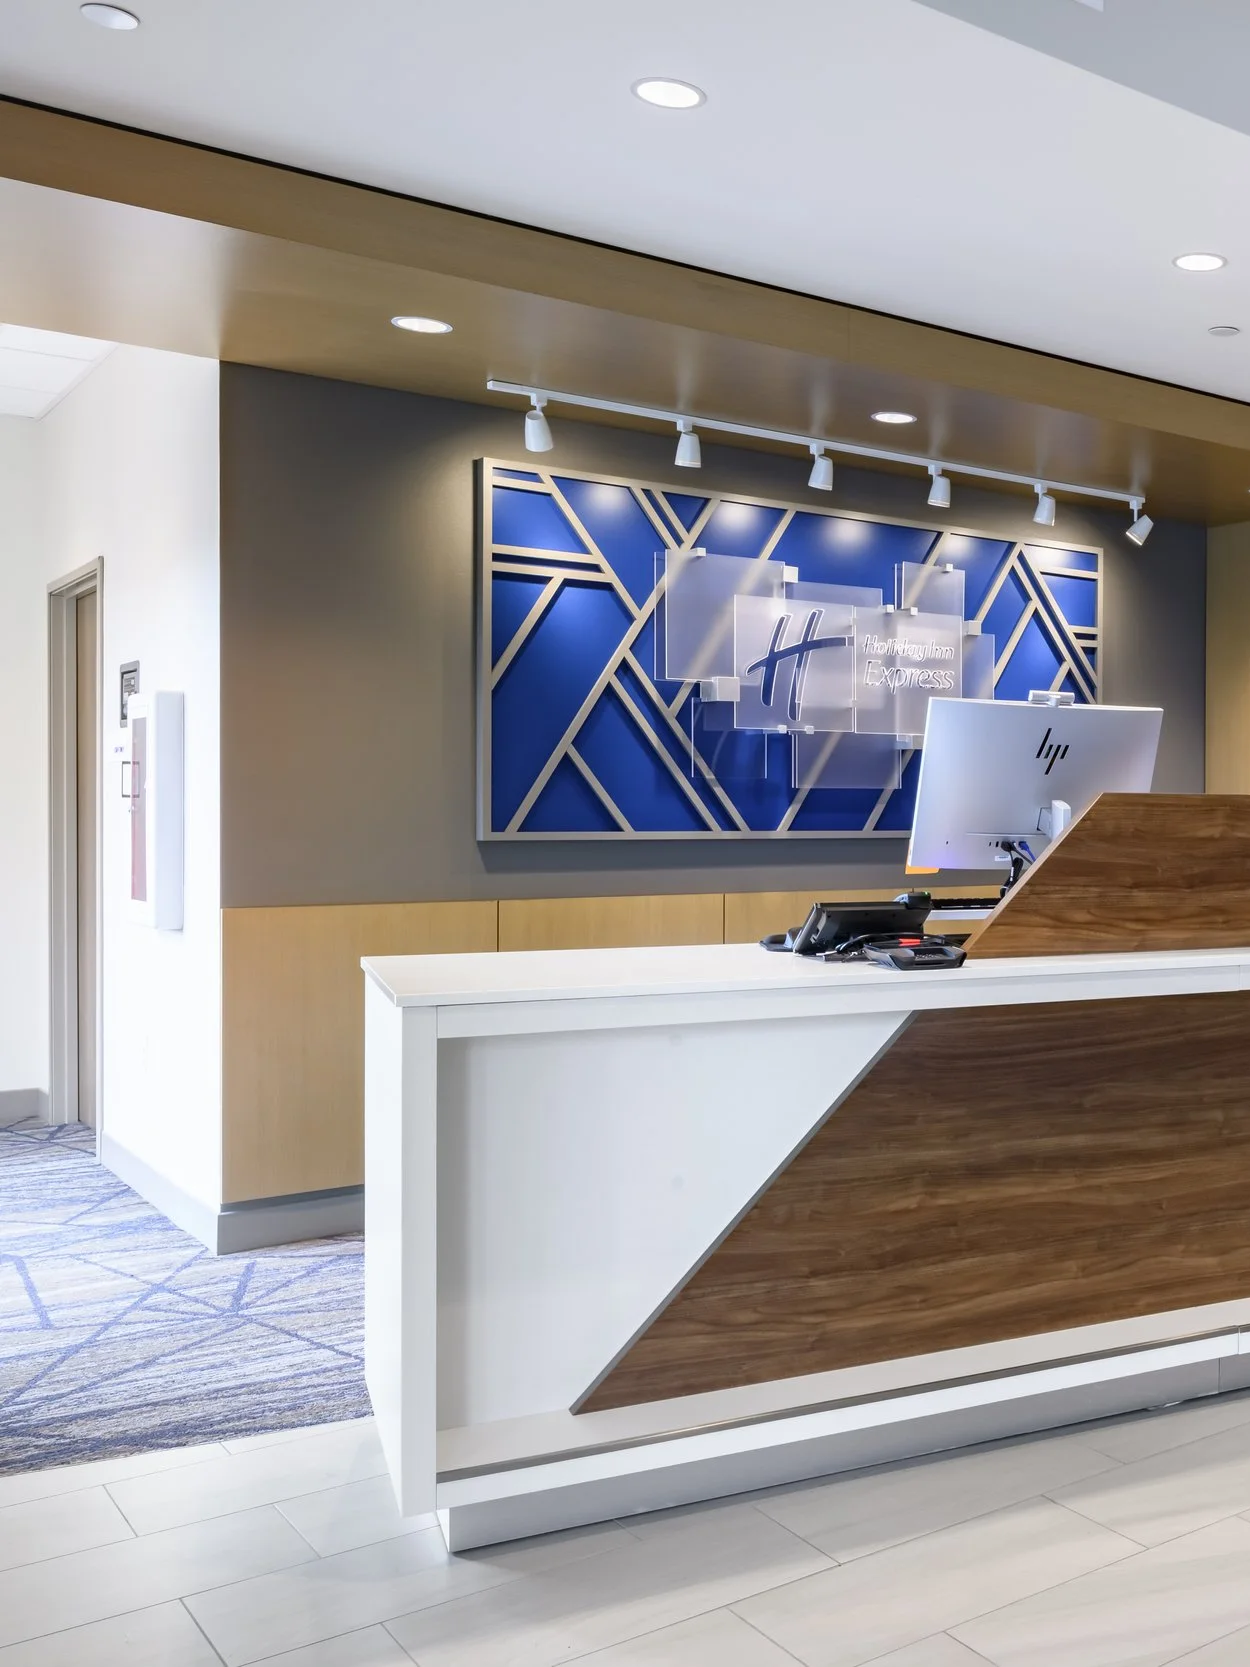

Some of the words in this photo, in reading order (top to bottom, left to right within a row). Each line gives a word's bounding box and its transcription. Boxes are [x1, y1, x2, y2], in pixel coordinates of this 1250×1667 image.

[862, 634, 927, 662] Holiday
[929, 639, 955, 659] Inn
[864, 659, 955, 694] Express
[1035, 727, 1070, 776] hp
